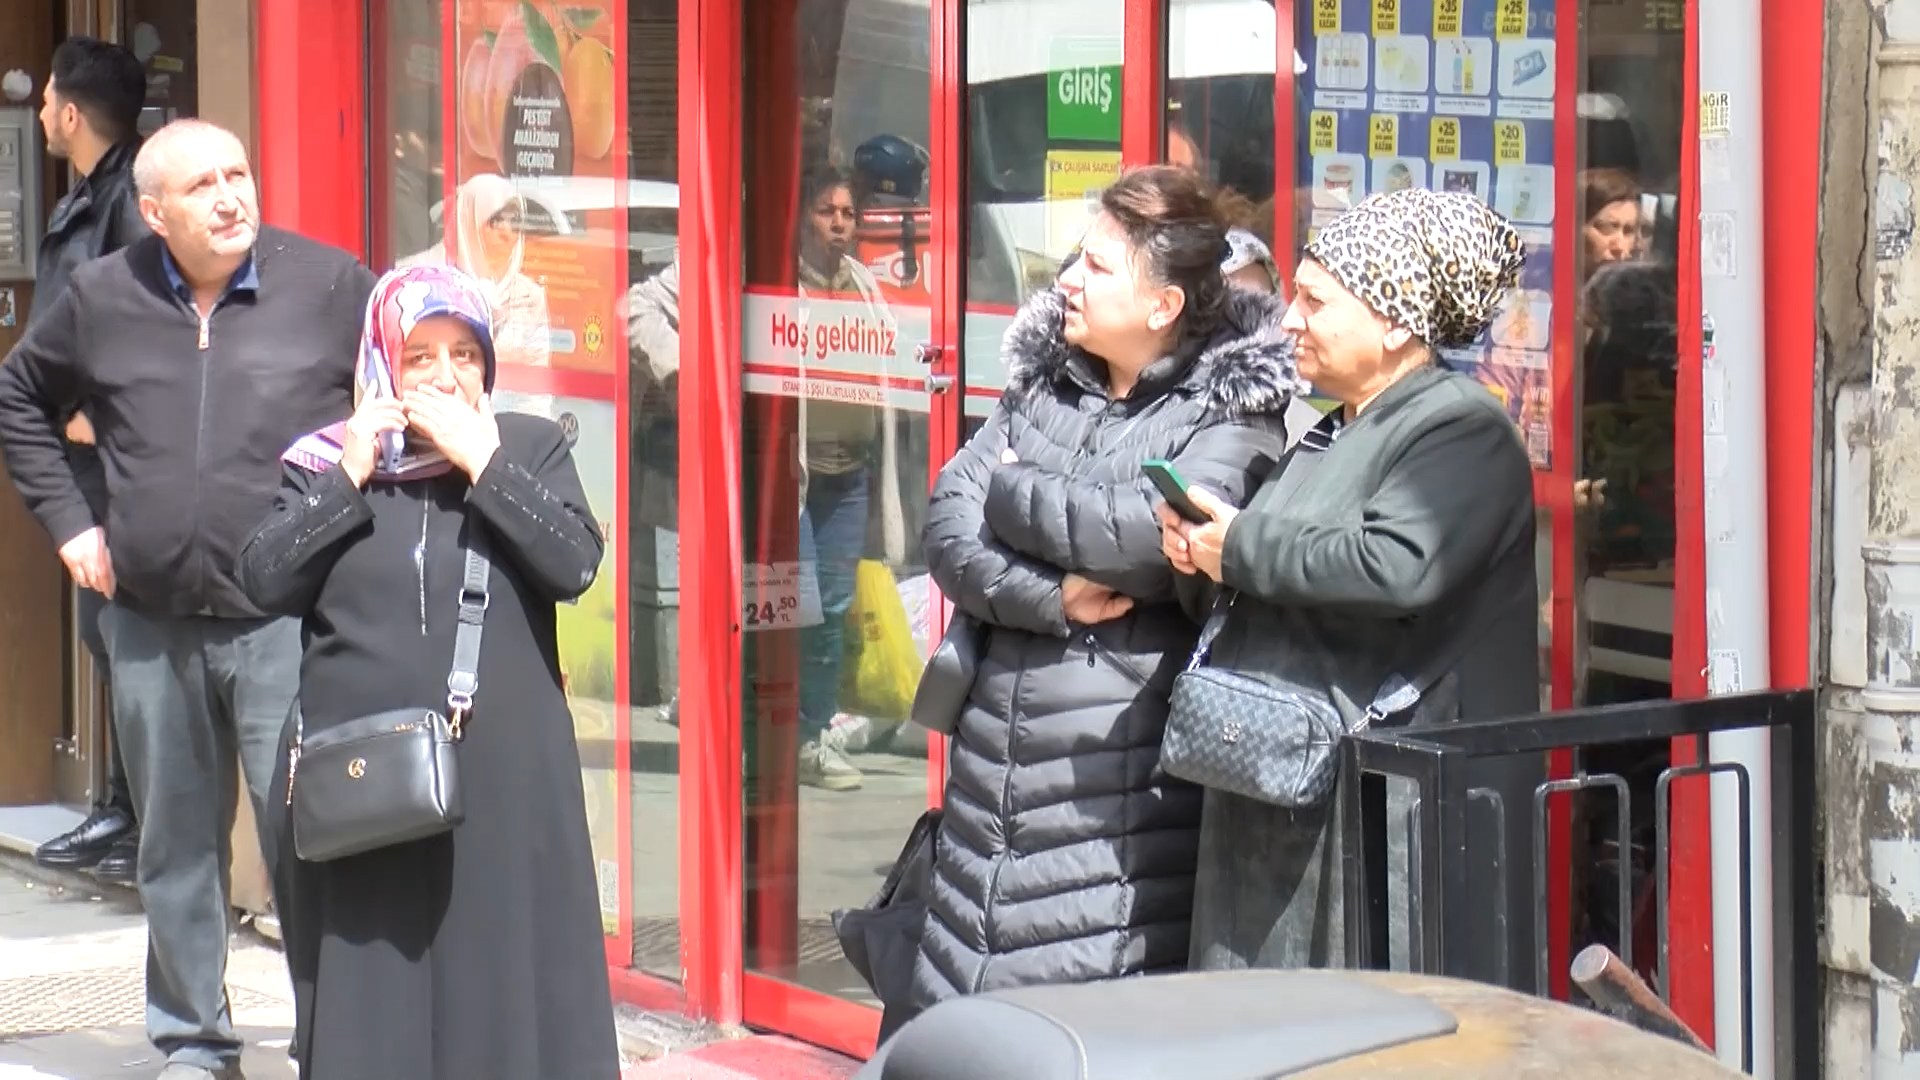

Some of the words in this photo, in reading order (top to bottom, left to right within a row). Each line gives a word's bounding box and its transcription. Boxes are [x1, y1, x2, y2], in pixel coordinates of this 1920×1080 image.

[1504, 1, 1523, 14] +25
[1058, 65, 1112, 114] GİRİŞ
[1438, 121, 1455, 136] +25
[1501, 125, 1519, 140] +20
[772, 313, 809, 356] Hoş
[816, 317, 897, 360] geldiniz
